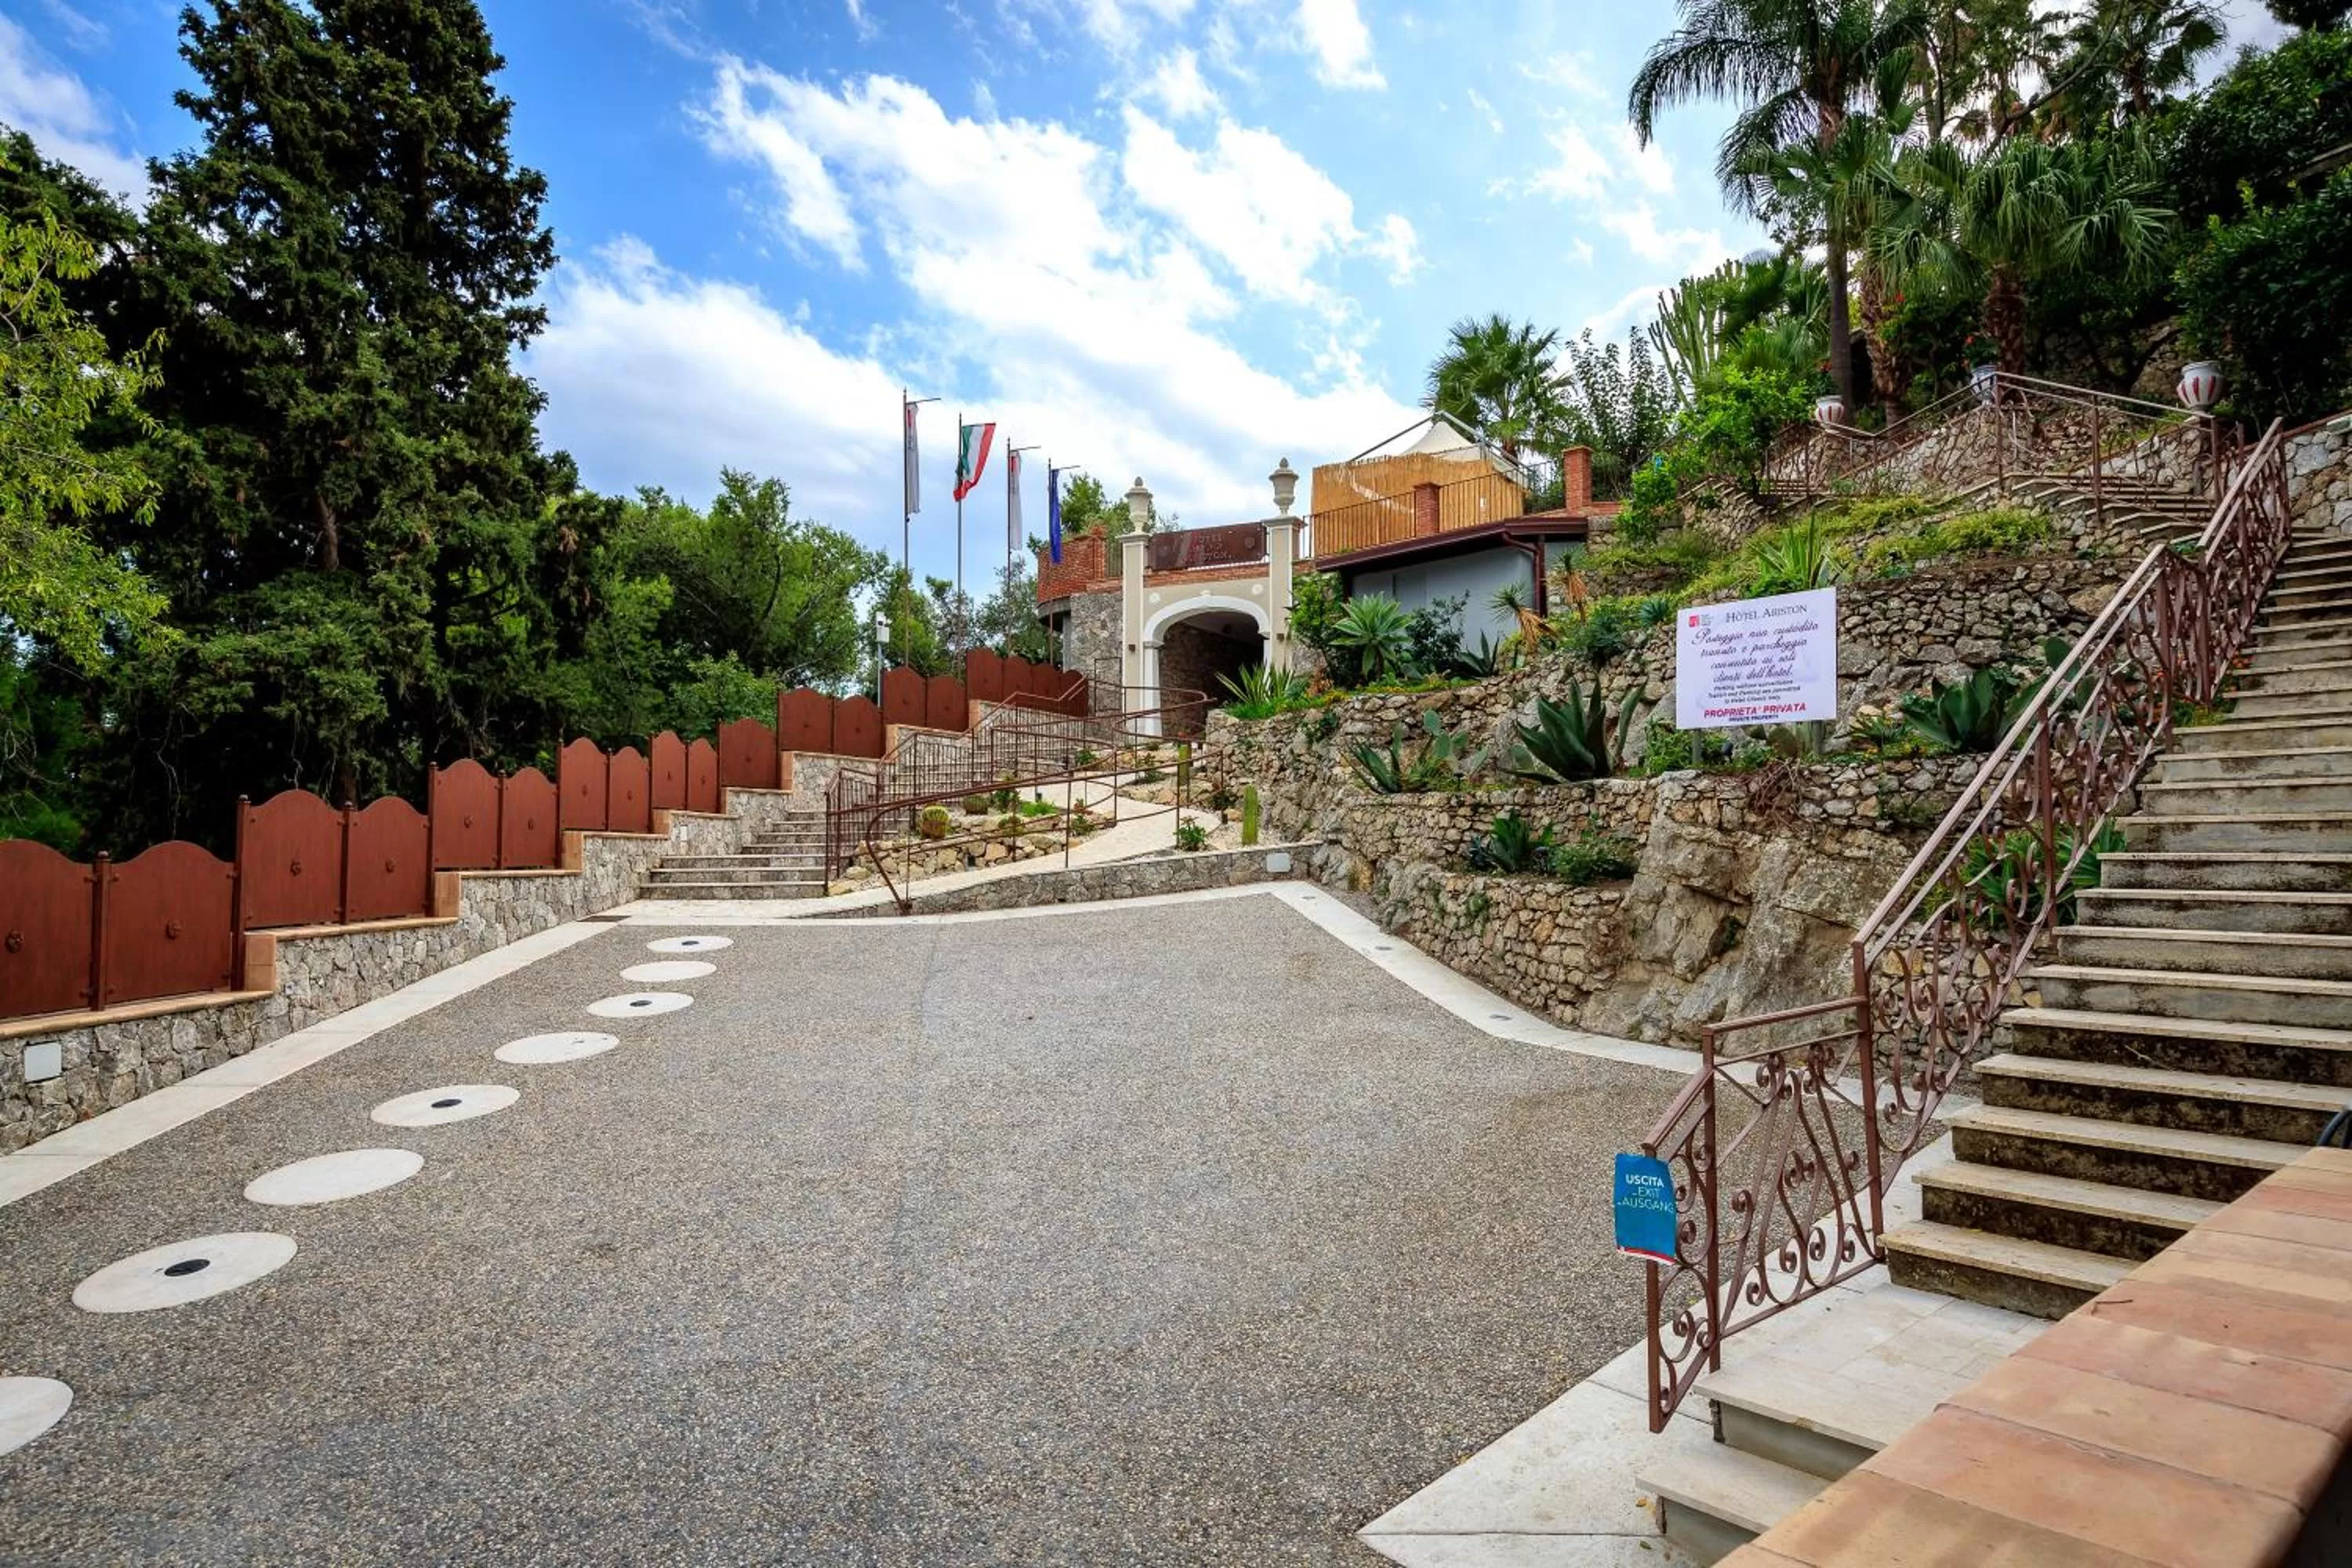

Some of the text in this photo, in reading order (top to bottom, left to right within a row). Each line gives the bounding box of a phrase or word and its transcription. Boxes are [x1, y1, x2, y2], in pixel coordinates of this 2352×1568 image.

[1762, 604, 1807, 618] ARISTON
[1691, 618, 1819, 646] Posteggio non custodito
[1749, 635, 1807, 655] parcheggio
[1710, 656, 1757, 670] consentito
[1778, 650, 1796, 662] soli
[1713, 670, 1741, 683] clienti
[1764, 702, 1807, 713] PRIVATA
[1625, 1174, 1664, 1188] USCITA
